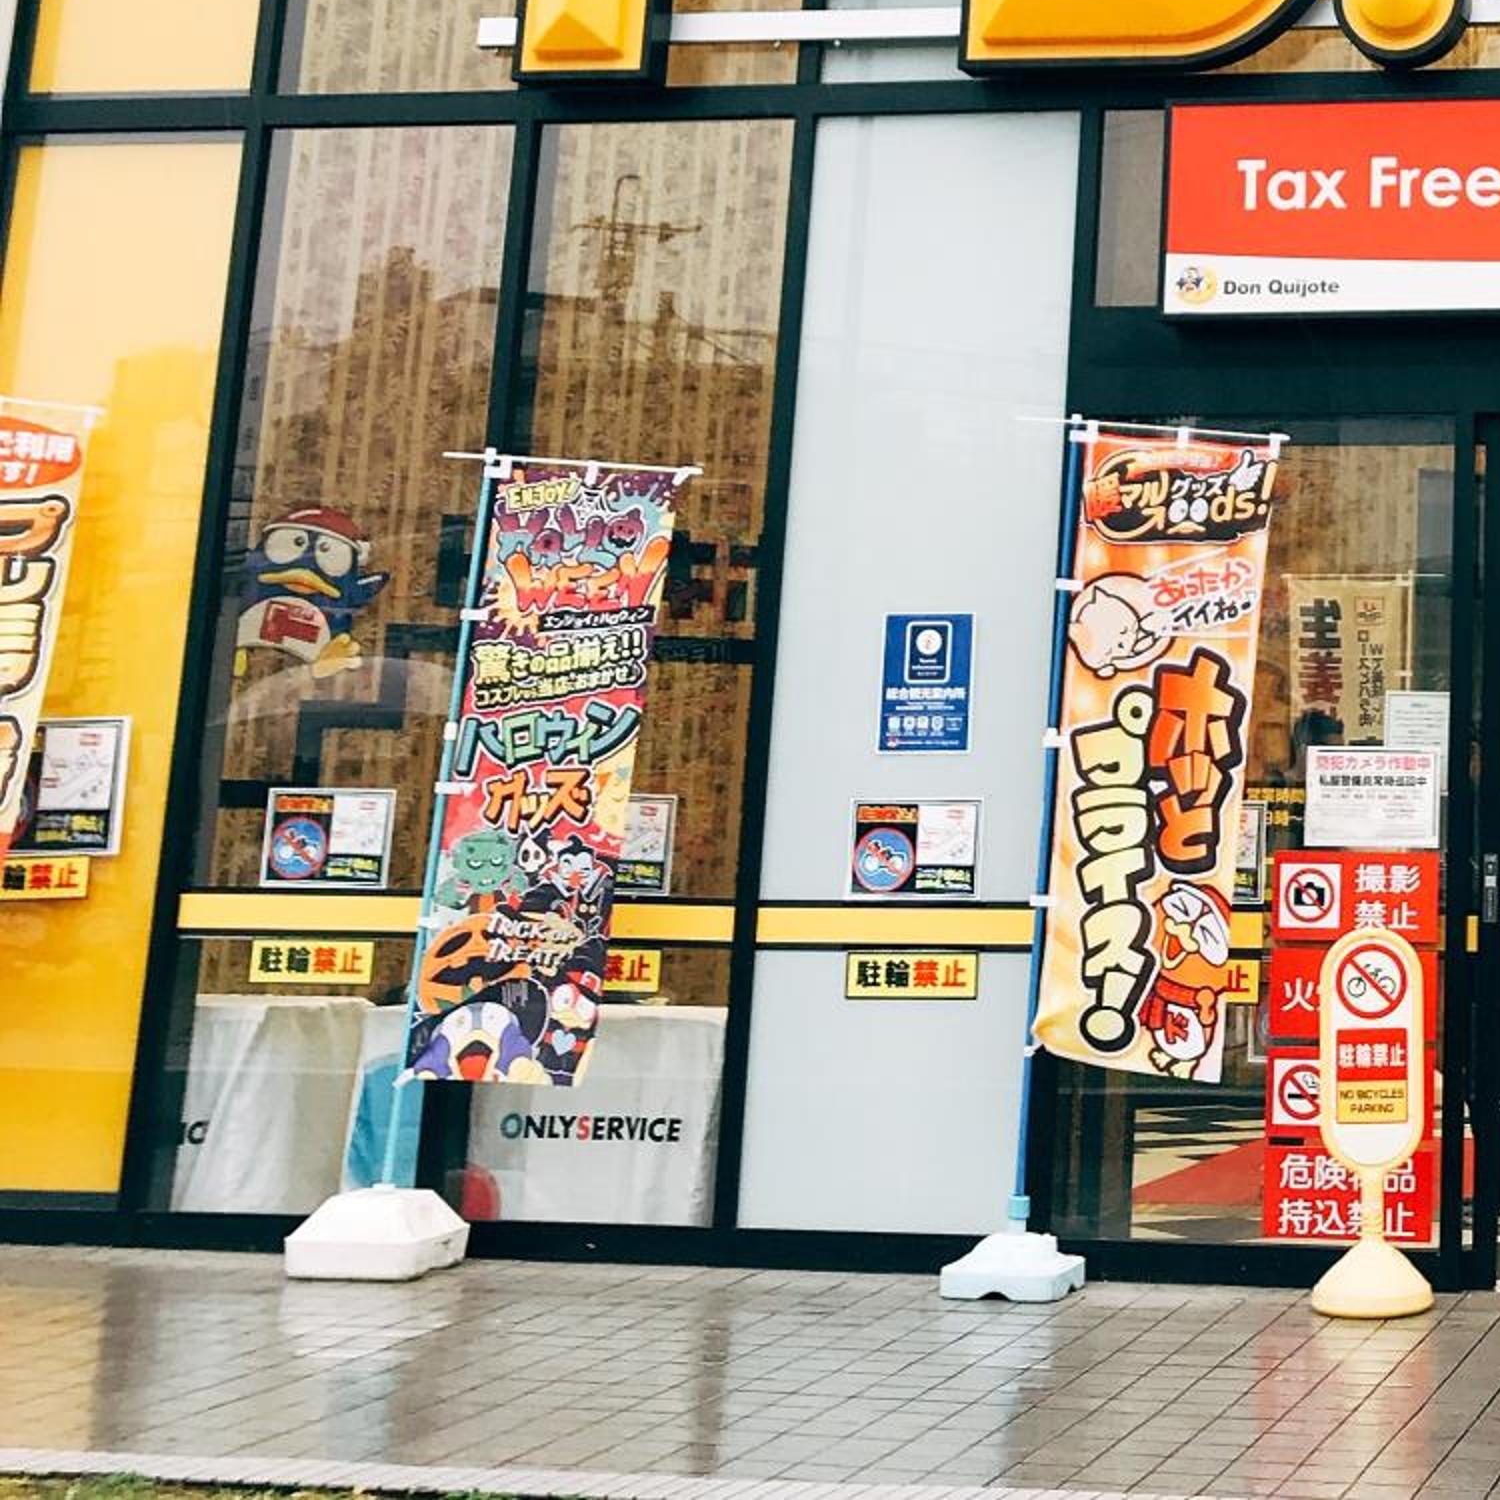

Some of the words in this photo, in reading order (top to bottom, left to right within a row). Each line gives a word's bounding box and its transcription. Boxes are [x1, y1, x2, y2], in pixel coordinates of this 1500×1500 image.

[1237, 158, 1347, 211] Tax
[1223, 279, 1262, 296] Don
[1268, 276, 1340, 300] Quijote
[454, 701, 643, 776] ハロウィン
[1151, 648, 1245, 870] ホッと
[484, 767, 592, 833] グッズ
[1071, 685, 1156, 1051] プライス!
[1354, 863, 1421, 895] 撮影
[1353, 901, 1420, 931] 禁止
[258, 947, 363, 974] 駐輪禁止
[856, 959, 967, 988] 駐輪禁止
[1339, 1042, 1406, 1069] 駐輪禁止
[1350, 1103, 1394, 1114] PARKING
[500, 1112, 683, 1143] ONLYSERVICE
